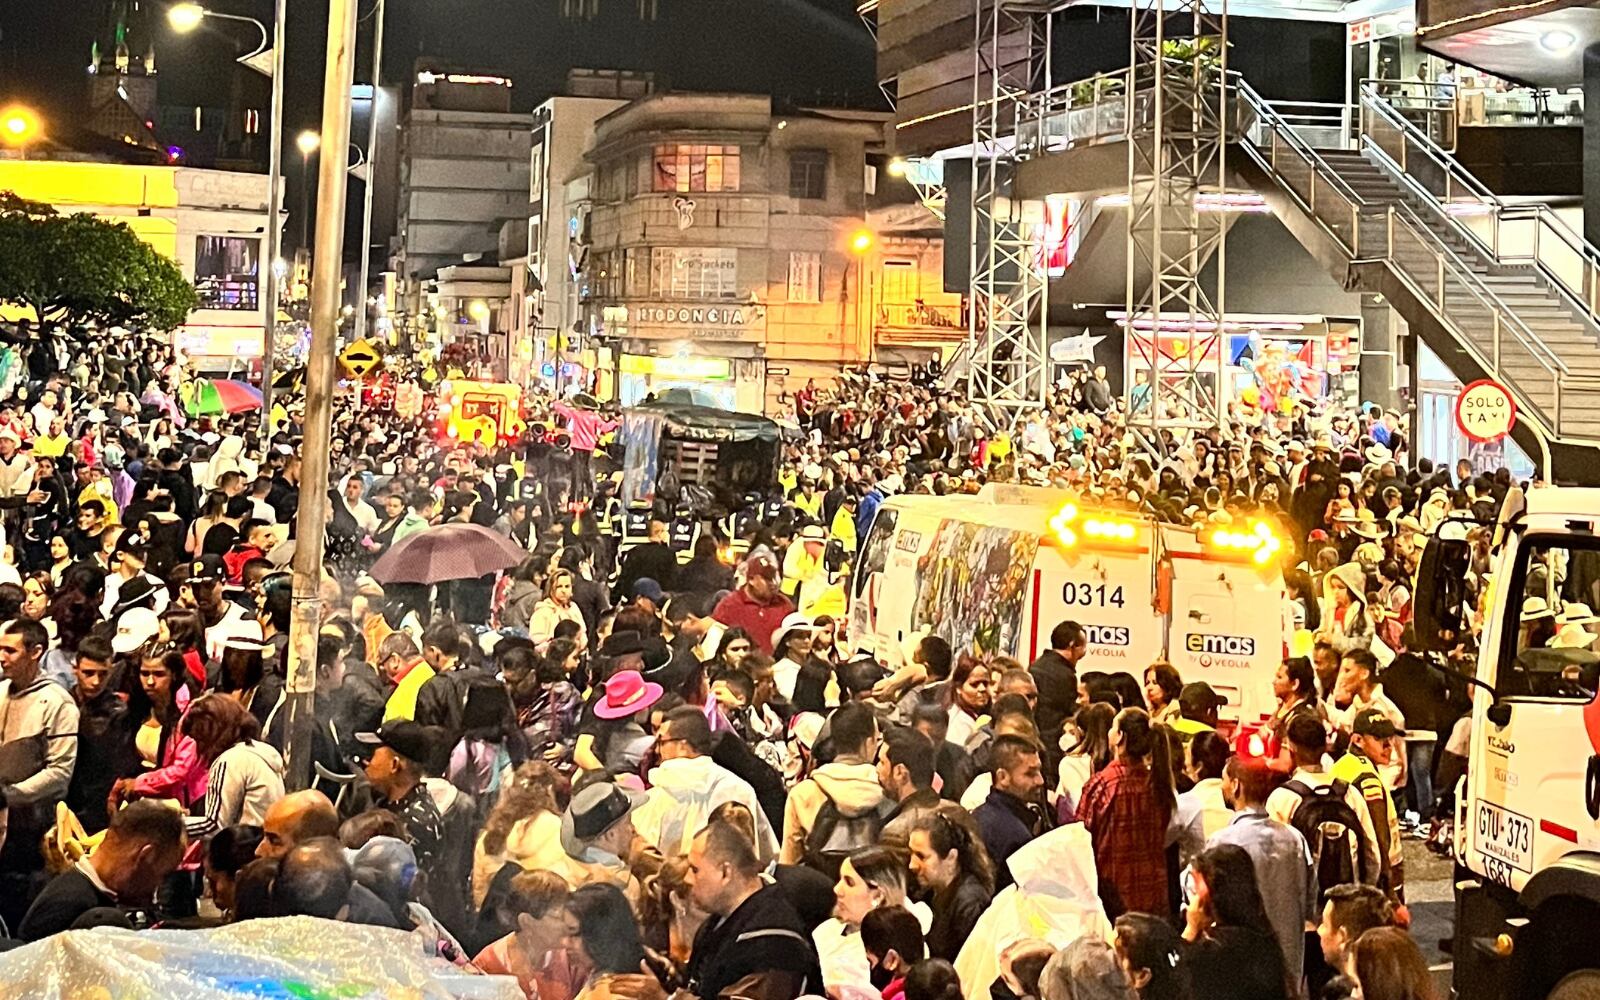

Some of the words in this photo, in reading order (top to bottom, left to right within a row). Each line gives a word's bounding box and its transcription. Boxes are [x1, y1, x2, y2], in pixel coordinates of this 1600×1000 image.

[1466, 397, 1504, 408] SOLO
[194, 562, 204, 576] P
[1062, 581, 1125, 608] 0314
[1083, 625, 1128, 645] mas
[1090, 648, 1126, 657] VEOLIA
[1187, 634, 1253, 655] emas
[1215, 658, 1250, 669] VEOLIA
[1482, 855, 1513, 889] 1687
